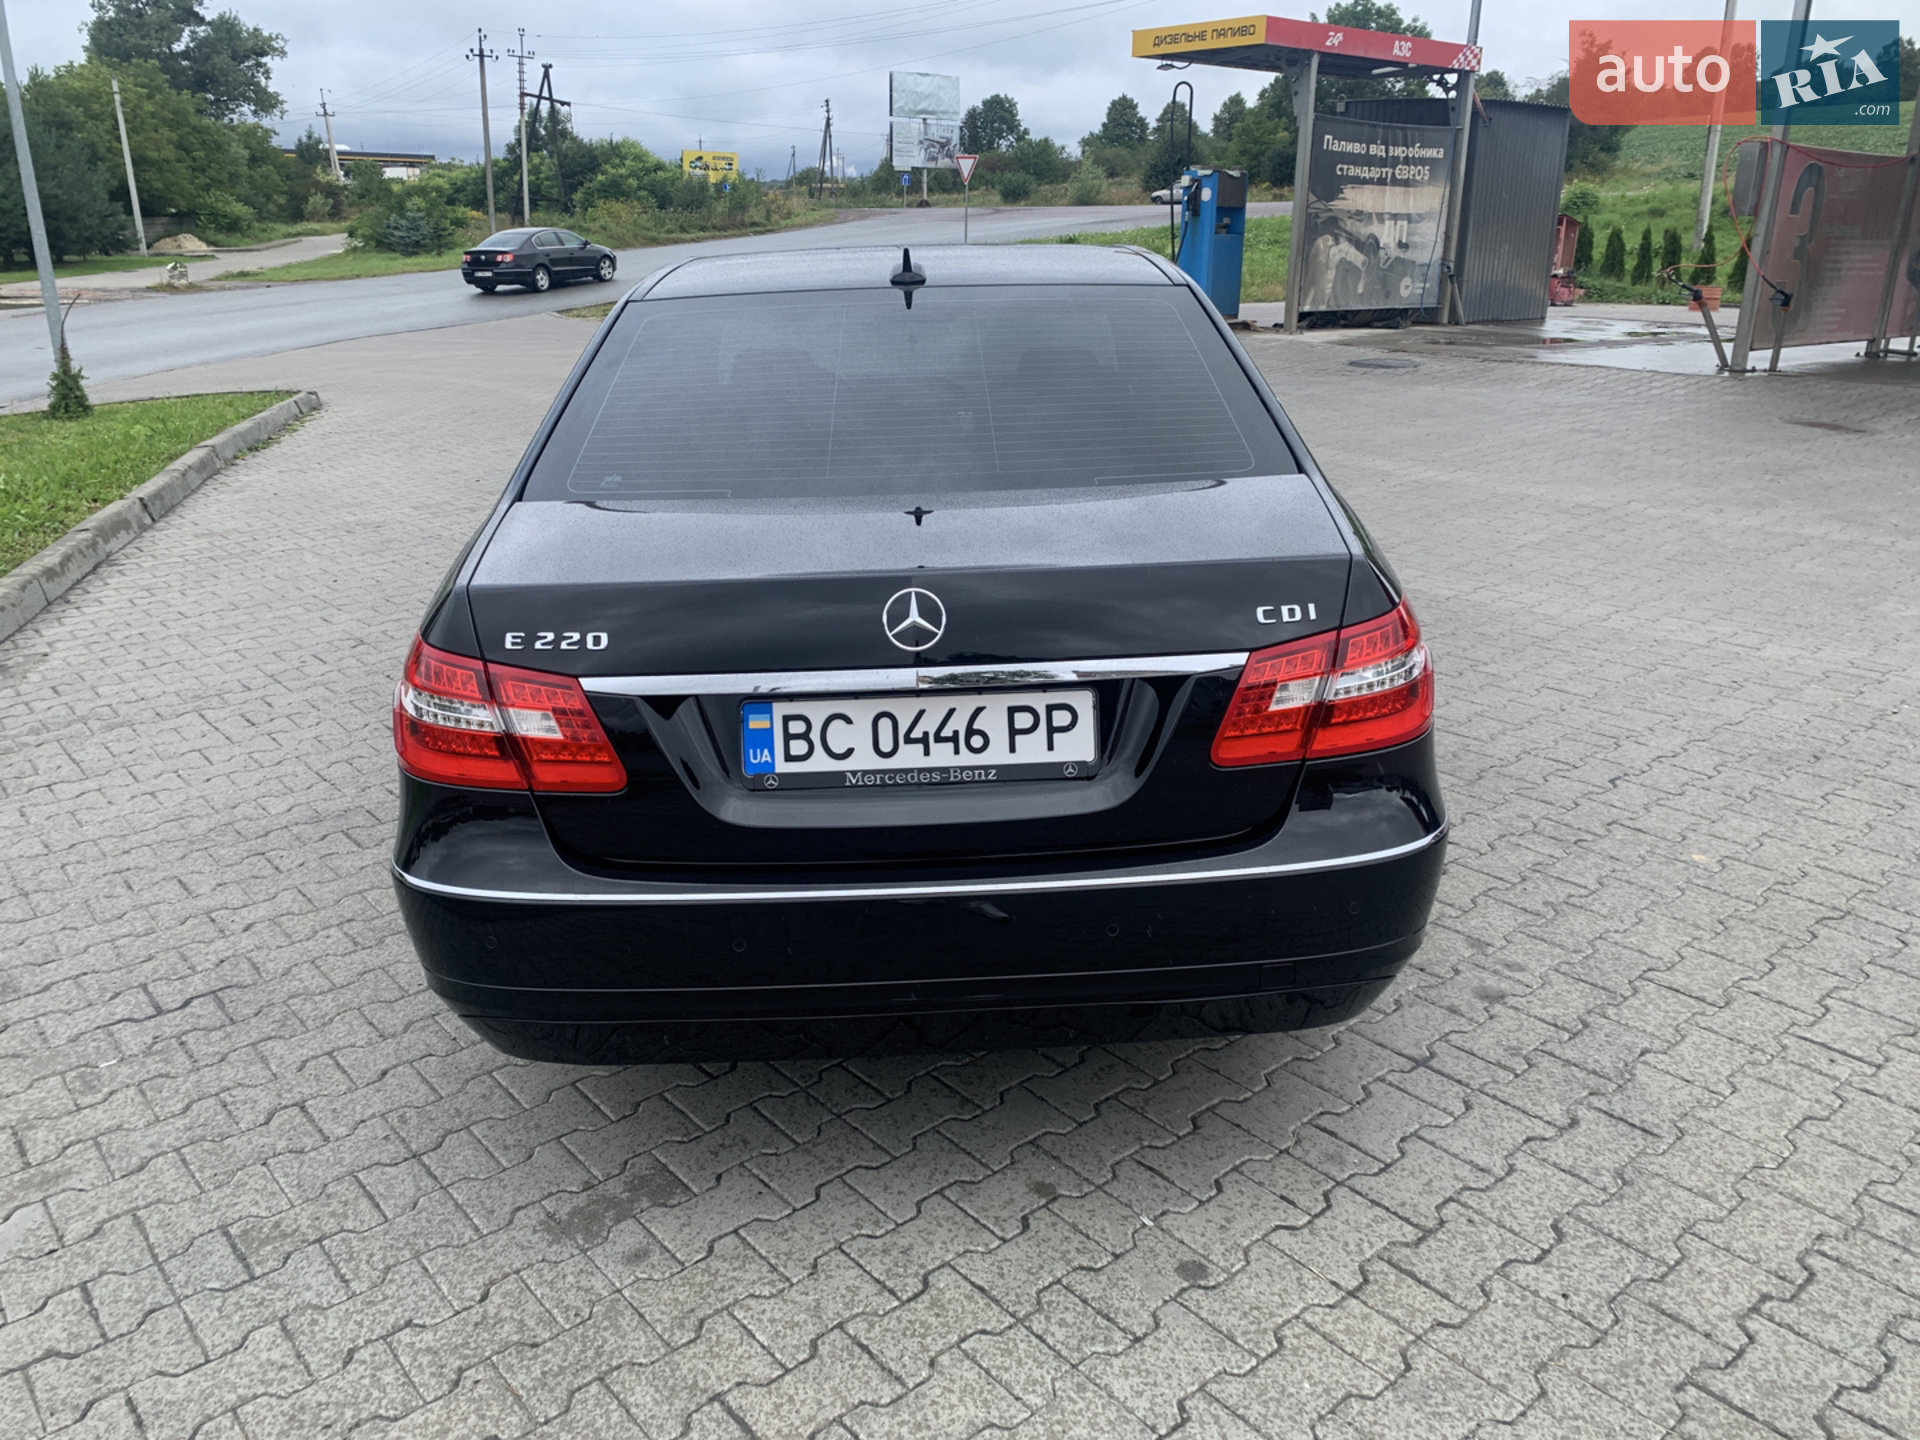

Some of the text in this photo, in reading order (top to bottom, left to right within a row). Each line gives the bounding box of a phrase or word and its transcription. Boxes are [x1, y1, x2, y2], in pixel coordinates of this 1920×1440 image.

[1153, 24, 1256, 48] ДИЗЕЛЬНЕ ПАЛИВО
[1392, 40, 1412, 57] АЗС
[1323, 134, 1444, 161] Паливо від виробника
[1336, 163, 1430, 183] стандарту ЄВРО5
[1256, 602, 1317, 624] CDI
[504, 631, 609, 651] E 220
[782, 702, 1079, 763] BC 0446 PP
[749, 748, 772, 764] UA
[844, 767, 998, 787] Mercedes-Benz
